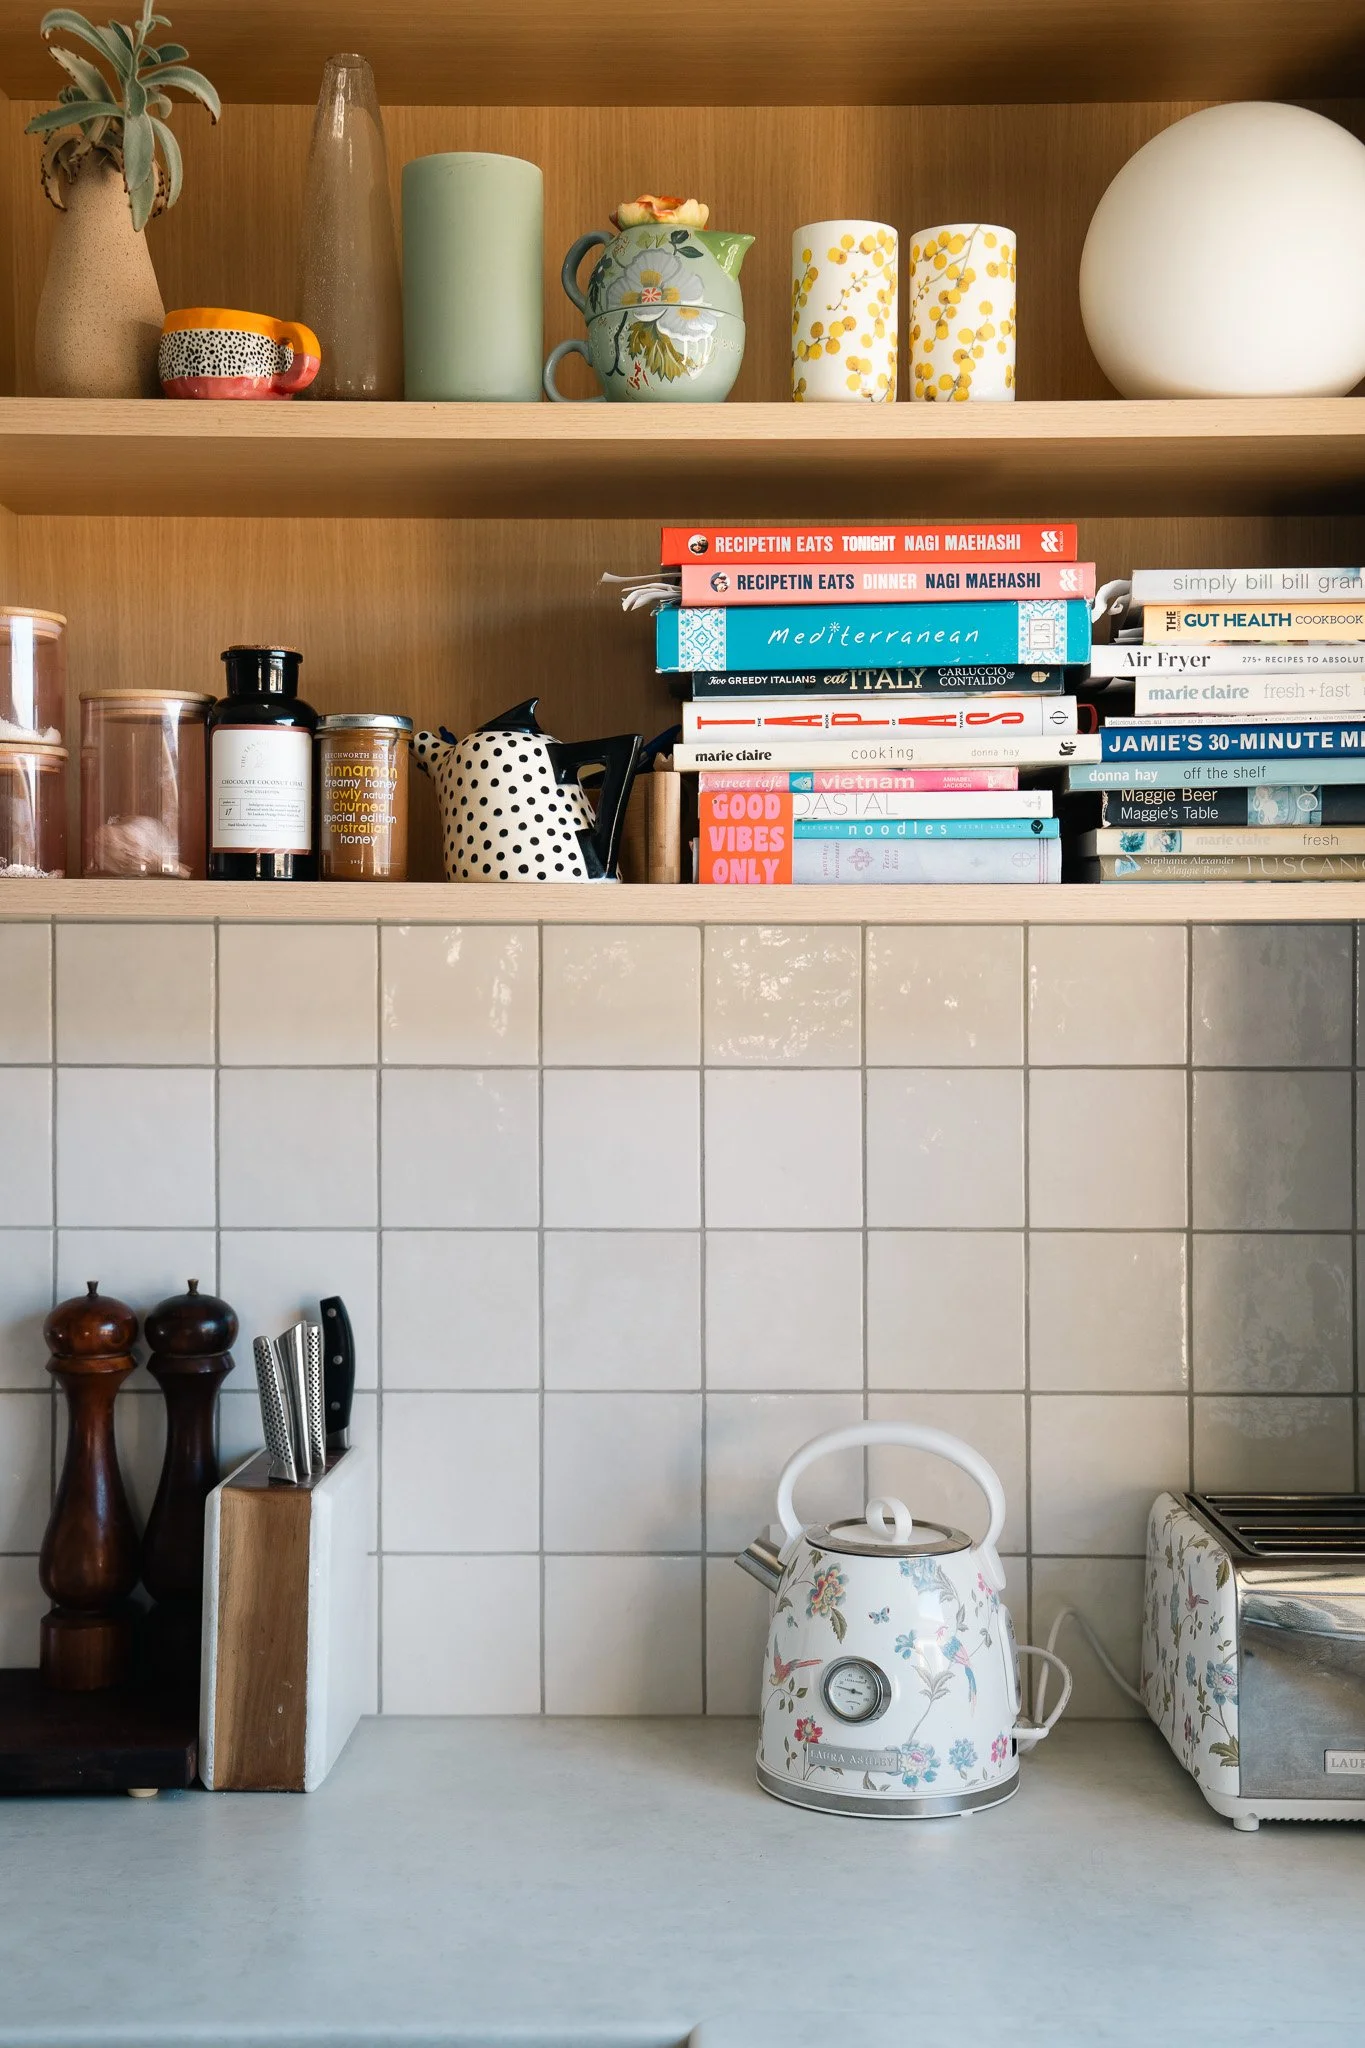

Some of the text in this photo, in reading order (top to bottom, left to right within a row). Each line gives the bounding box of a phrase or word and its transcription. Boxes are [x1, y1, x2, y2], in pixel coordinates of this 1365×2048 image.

[715, 534, 1021, 552] RECIPETIN EATS TONIGHT NAGI MAEHASHI
[737, 572, 1041, 590] RECIPETIN EATS DINNER NAGI MAEHASHI
[1173, 574, 1237, 594] simply
[1246, 573, 1273, 590] bill
[1282, 573, 1309, 590] bill
[1166, 610, 1177, 632] THE
[1184, 613, 1364, 627] GUT HEALTH COOKBOOK
[767, 621, 980, 647] Mediterranean
[1122, 652, 1211, 672] Air Fryer
[707, 669, 927, 690] Two GREEDY ITALIANS eat ITALY
[938, 667, 1016, 680] CARLUCCIO &
[939, 676, 1006, 686] CONTALDO
[1148, 686, 1198, 700] marie
[1202, 684, 1249, 700] claire
[1264, 682, 1305, 698] fresh
[1318, 683, 1351, 698] fast
[1109, 734, 1203, 753] JAMIE'S
[1208, 731, 1334, 751] 30-MINUTE
[695, 746, 1020, 762] marie claire cooking donna hay
[324, 764, 398, 779] cinnamon
[1089, 765, 1267, 784] donna hay off the shelf
[324, 778, 397, 791] creamy honey
[714, 774, 915, 792] street café vietnam
[326, 788, 394, 802] slowly natural
[1121, 788, 1218, 805] Maggie Beer
[333, 800, 387, 813] churned
[712, 793, 781, 820] GOOD
[1121, 806, 1219, 822] Maggie's Table
[323, 812, 397, 825] special edition
[330, 822, 388, 835] australian
[848, 821, 947, 835] noodles
[340, 833, 377, 847] honey
[708, 825, 785, 852] VIBES
[1196, 834, 1233, 846] marie
[1303, 834, 1339, 846] fresh
[1144, 857, 1186, 867] Stephanie
[1190, 857, 1235, 865] Alexander
[712, 858, 780, 884] ONLY
[1166, 866, 1198, 877] Maggie
[810, 1750, 894, 1768] LAURA ASHLEY
